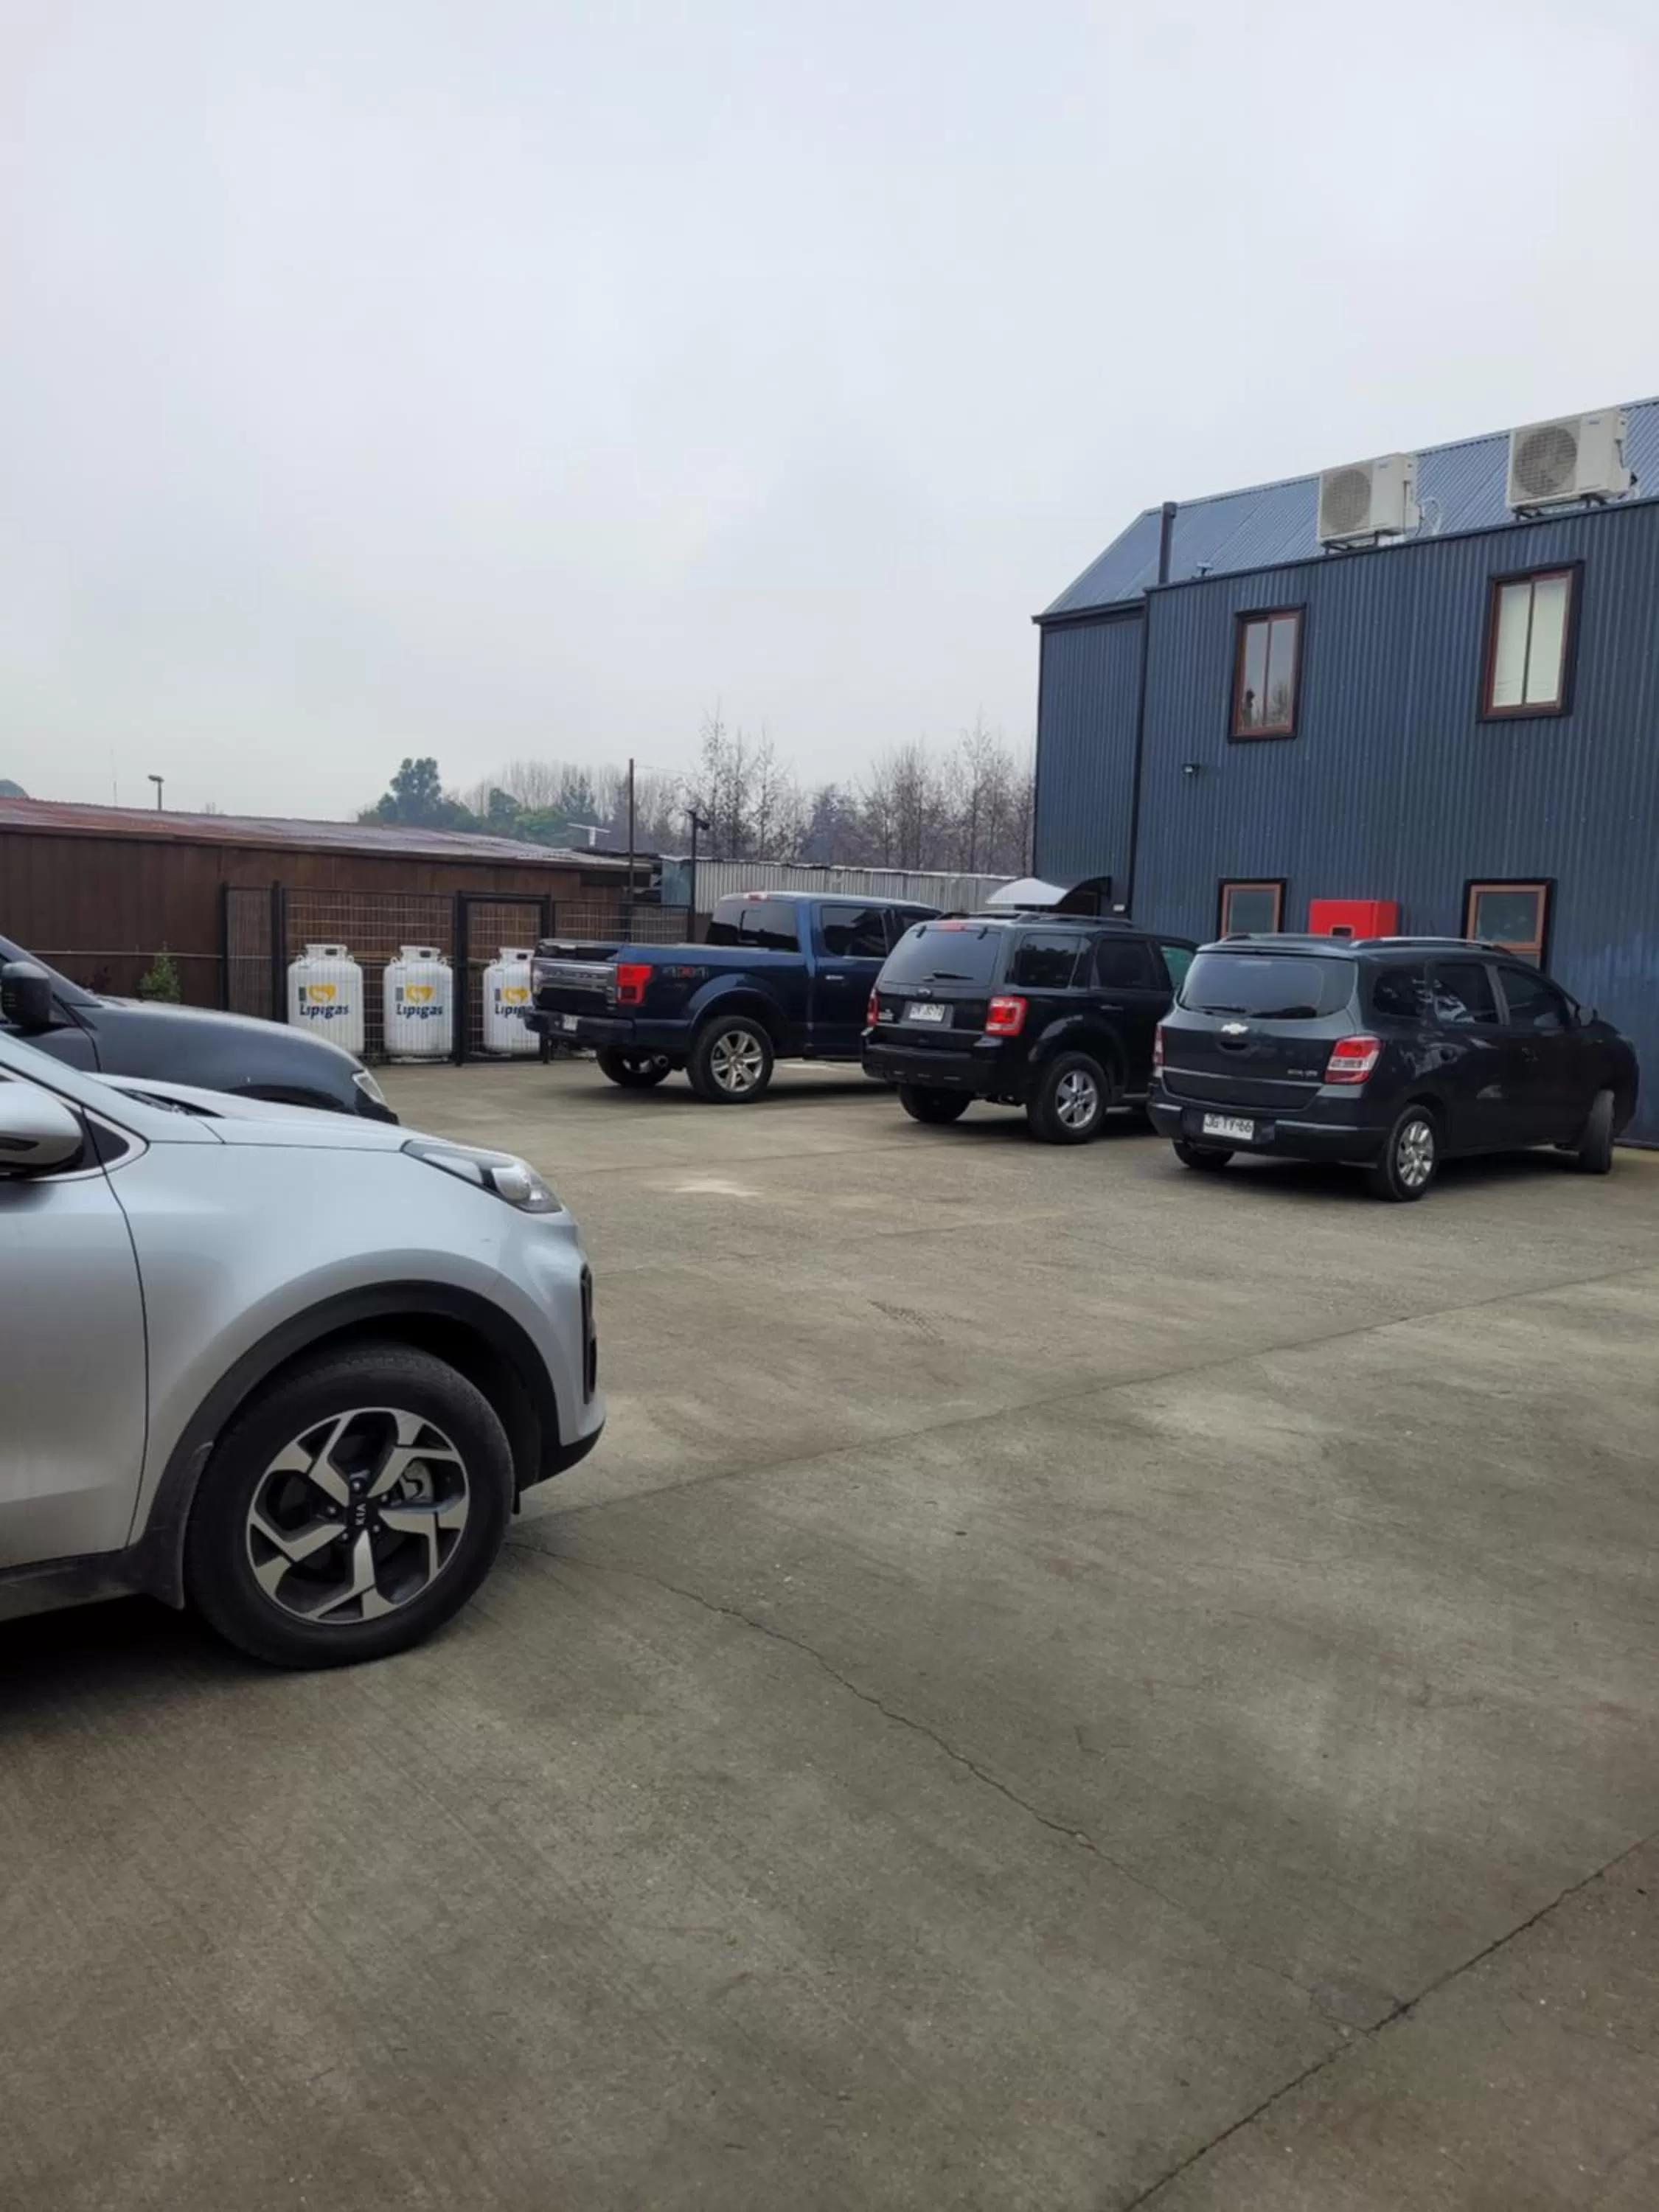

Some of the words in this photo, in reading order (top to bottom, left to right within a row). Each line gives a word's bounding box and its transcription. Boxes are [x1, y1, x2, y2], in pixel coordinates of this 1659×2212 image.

[299, 1003, 349, 1020] Lipigas
[396, 1004, 443, 1020] Lipigas
[495, 1004, 533, 1019] Lipig
